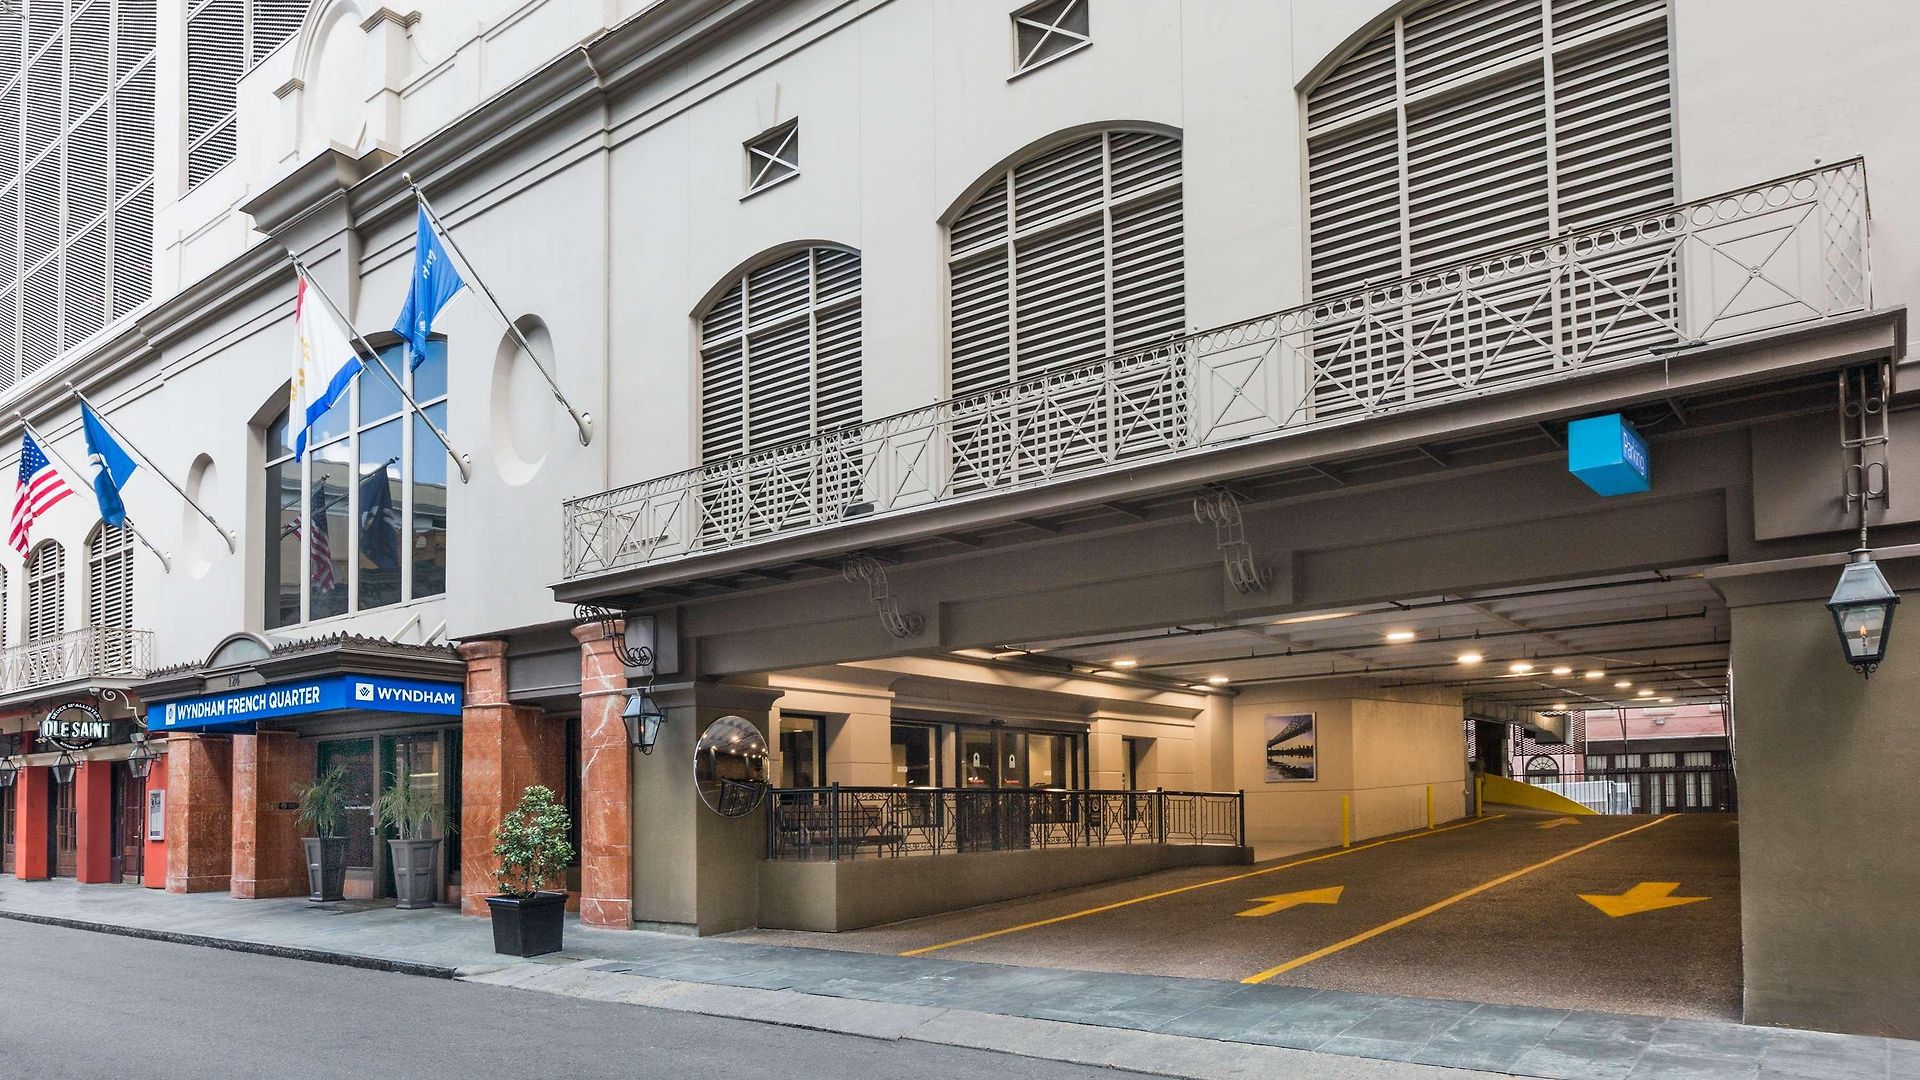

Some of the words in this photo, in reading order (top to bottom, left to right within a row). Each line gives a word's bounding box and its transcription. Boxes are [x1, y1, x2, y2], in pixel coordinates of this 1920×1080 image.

[1623, 431, 1645, 476] Parking
[177, 699, 225, 721] WYNDHAM
[227, 693, 266, 715] FRENCH
[268, 686, 320, 709] QUARTER
[377, 687, 455, 705] WYNDHAM
[44, 720, 69, 737] OLE
[71, 721, 110, 738] SAINT
